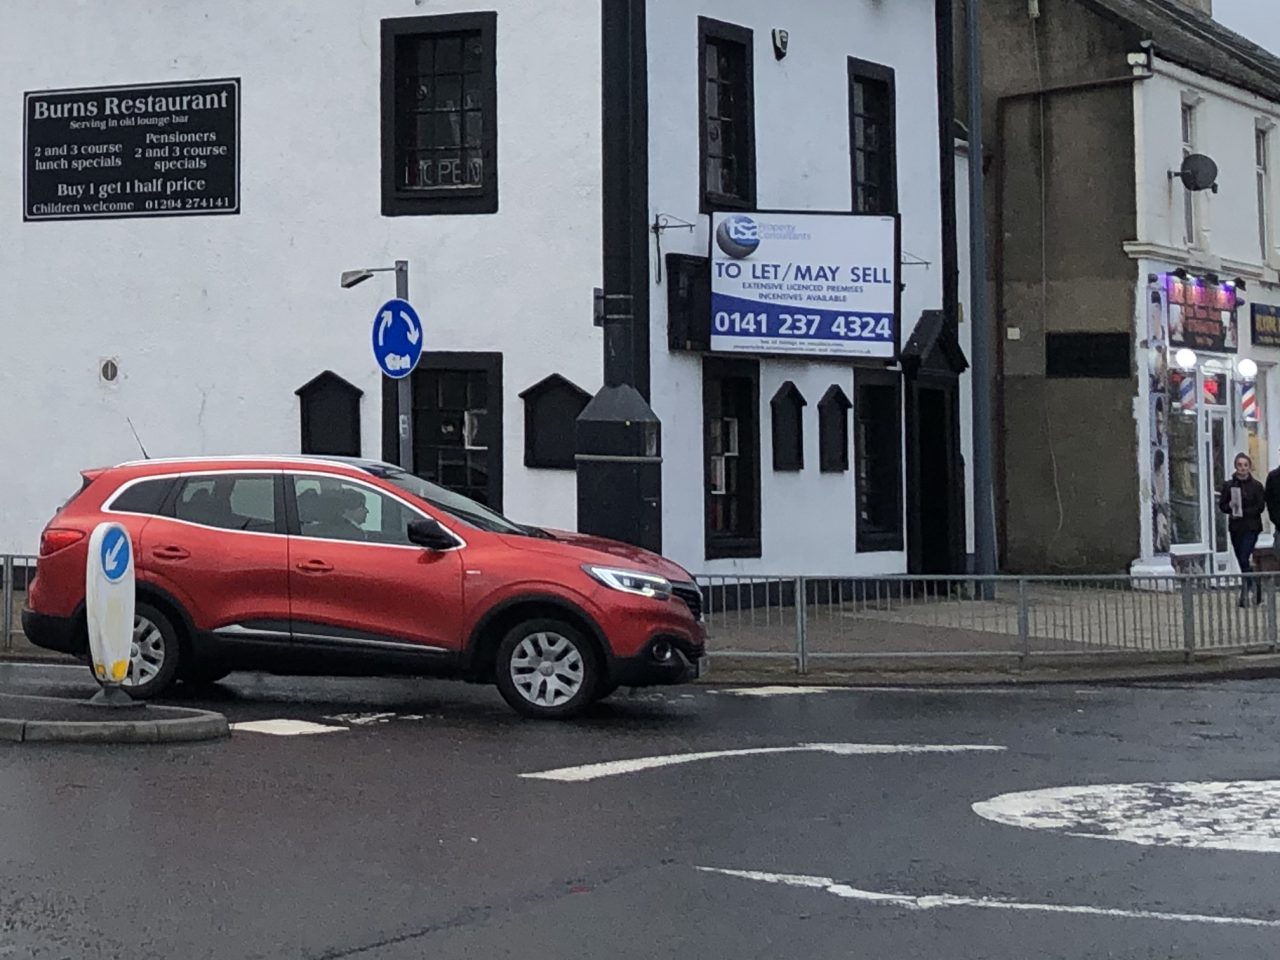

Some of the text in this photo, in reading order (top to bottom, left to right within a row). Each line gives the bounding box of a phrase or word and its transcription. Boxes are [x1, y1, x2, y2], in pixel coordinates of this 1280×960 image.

[34, 90, 228, 119] Burns Restaurant
[69, 113, 189, 130] Serving in old lounge bar
[146, 131, 217, 144] Pensioners
[34, 143, 122, 157] 2 and 3 course
[134, 145, 227, 158] 2 and 3 course
[35, 155, 122, 171] lunch specials
[154, 157, 207, 173] specials
[57, 183, 85, 198] Buy
[98, 182, 121, 198] get
[134, 178, 163, 193] half
[166, 176, 206, 195] price
[32, 202, 80, 214] Children
[83, 200, 134, 212] welcome
[185, 196, 229, 208] 274141
[715, 262, 891, 284] TO LET/MAY SELL
[742, 282, 783, 290] EXTENSIVE
[826, 285, 864, 293] PREMISES
[758, 293, 847, 303] INCENTIVES AVAILABLE
[715, 311, 892, 338] 0141 237 4324
